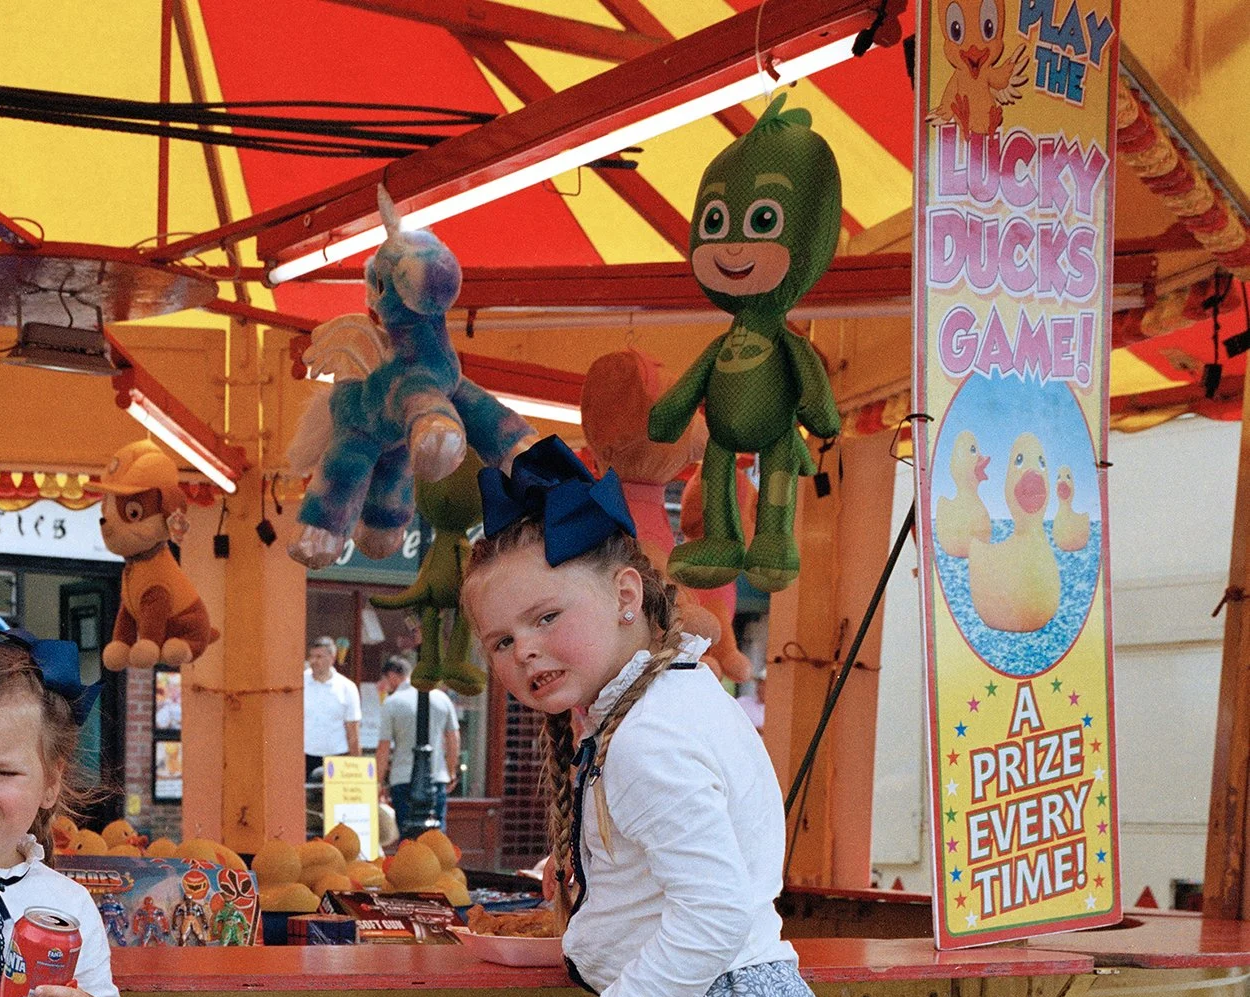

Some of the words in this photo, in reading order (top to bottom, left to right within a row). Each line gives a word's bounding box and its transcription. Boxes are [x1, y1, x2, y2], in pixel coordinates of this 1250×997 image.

[1018, 0, 1114, 67] PLAY
[1035, 45, 1087, 104] THE
[937, 124, 1109, 216] LUCKY
[928, 208, 1098, 301] DUCKS
[939, 305, 1094, 386] GAME!
[1009, 682, 1043, 737] A
[971, 725, 1084, 803] PRIZE
[967, 780, 1093, 863] EVERY
[971, 840, 1087, 919] TIME!
